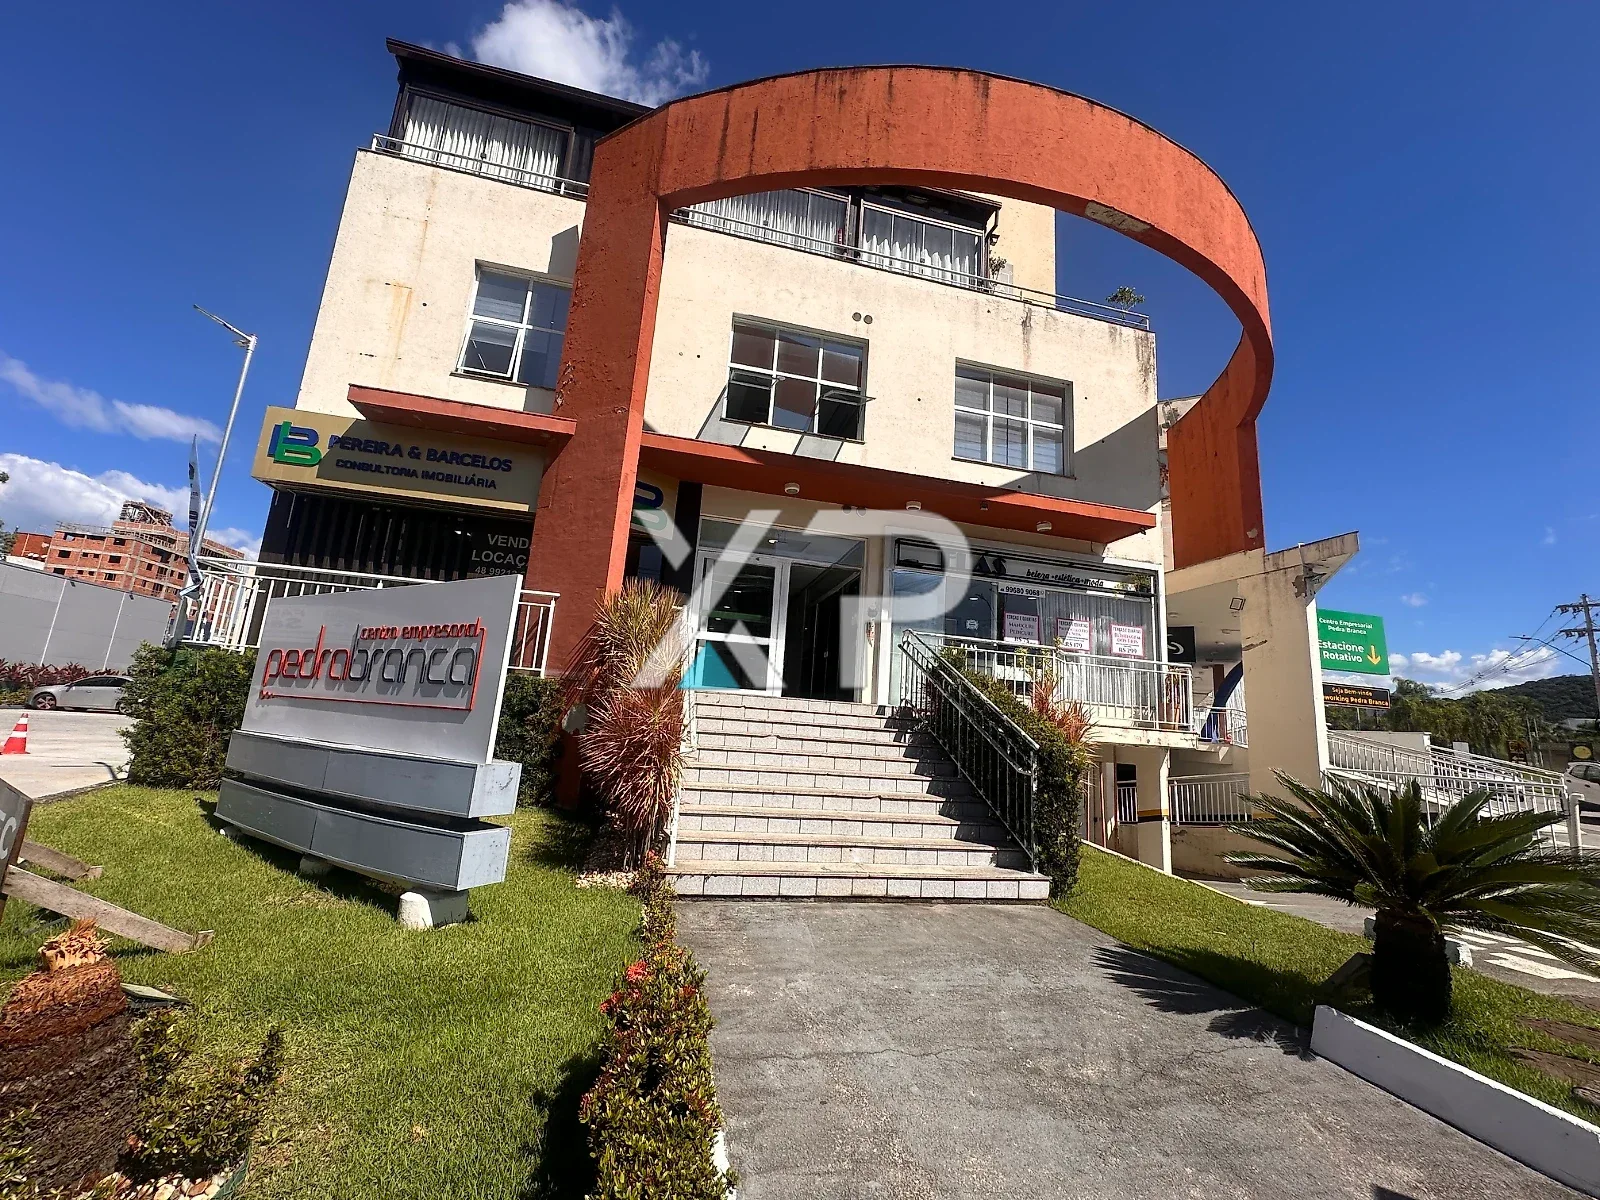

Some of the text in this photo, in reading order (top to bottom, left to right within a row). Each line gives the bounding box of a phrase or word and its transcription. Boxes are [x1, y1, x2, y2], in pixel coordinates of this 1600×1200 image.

[328, 434, 513, 473] PEREIRA & BARCELOS
[335, 458, 497, 490] CONSULTORIA IMOBILIÁRIA
[487, 533, 529, 549] VEND
[471, 549, 527, 569] LOCAÇ
[1318, 617, 1373, 629] Centro Empresarial
[1346, 627, 1367, 635] Branca
[1318, 640, 1365, 653] Estacione
[1322, 650, 1363, 663] Rotativo
[1324, 695, 1350, 703] working
